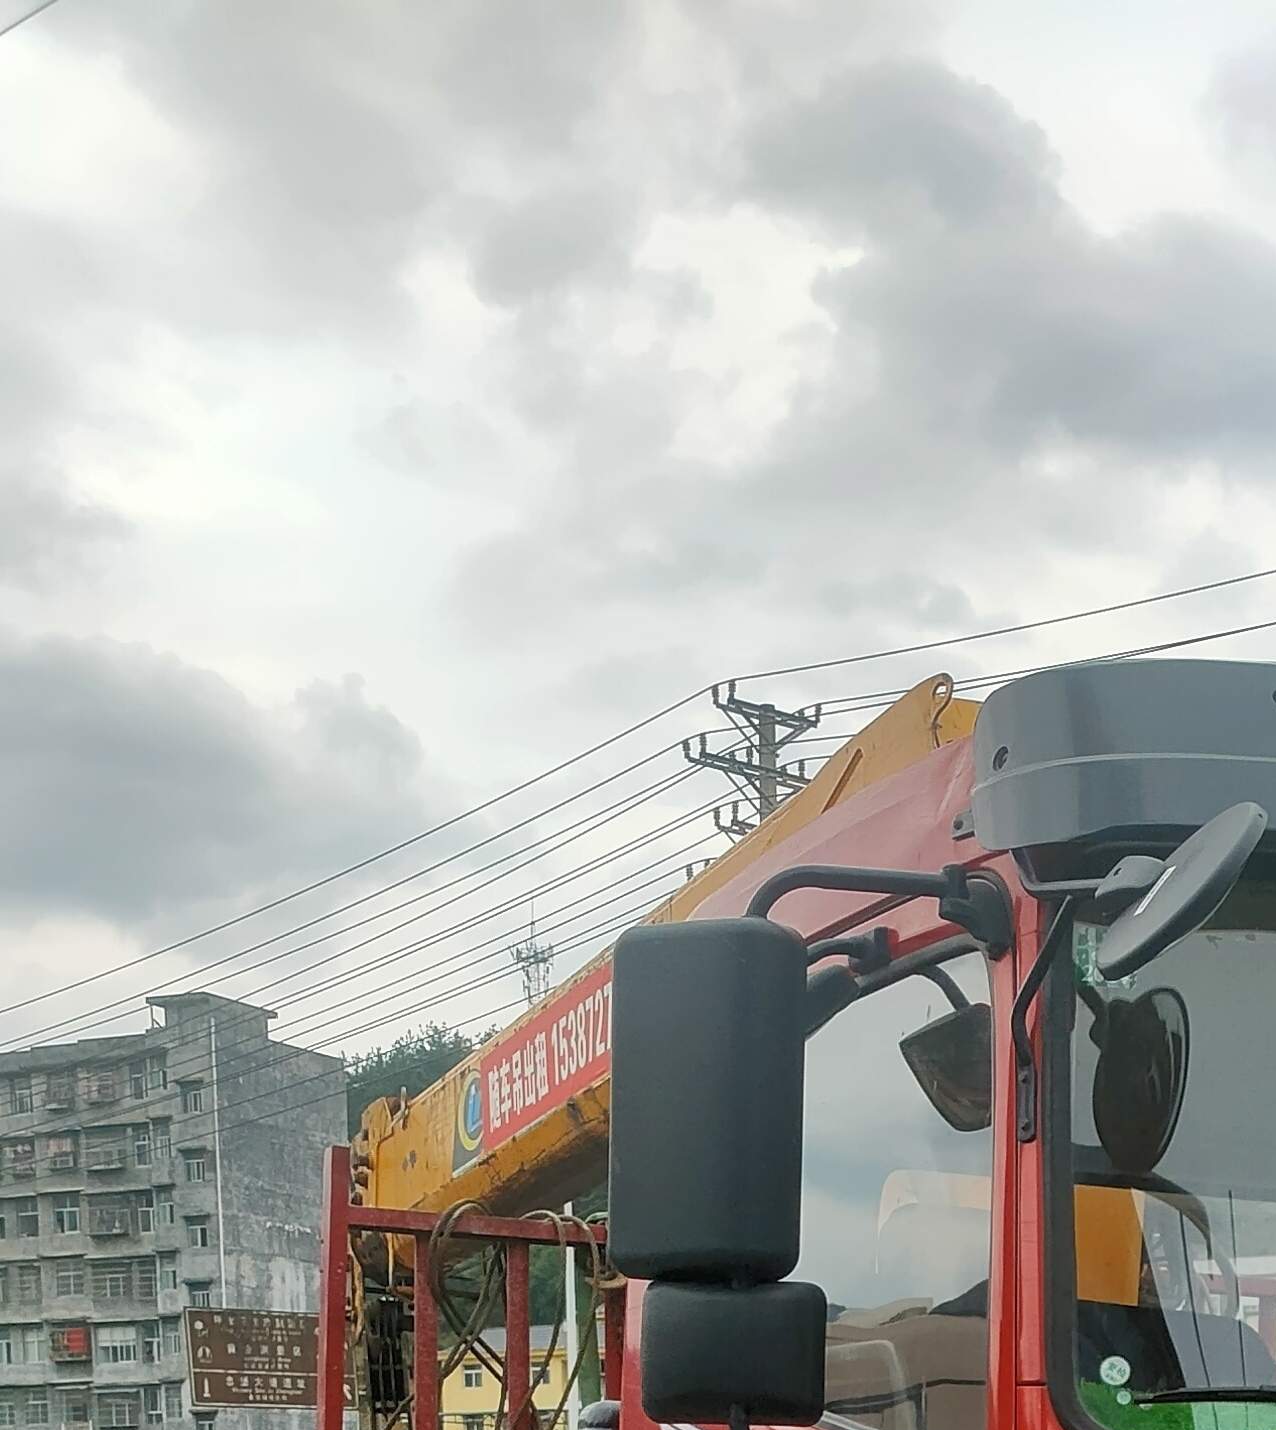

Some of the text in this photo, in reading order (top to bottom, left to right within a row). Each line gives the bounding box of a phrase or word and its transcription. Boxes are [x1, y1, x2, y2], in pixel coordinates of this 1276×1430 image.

[488, 1031, 549, 1133] 随车吊出租
